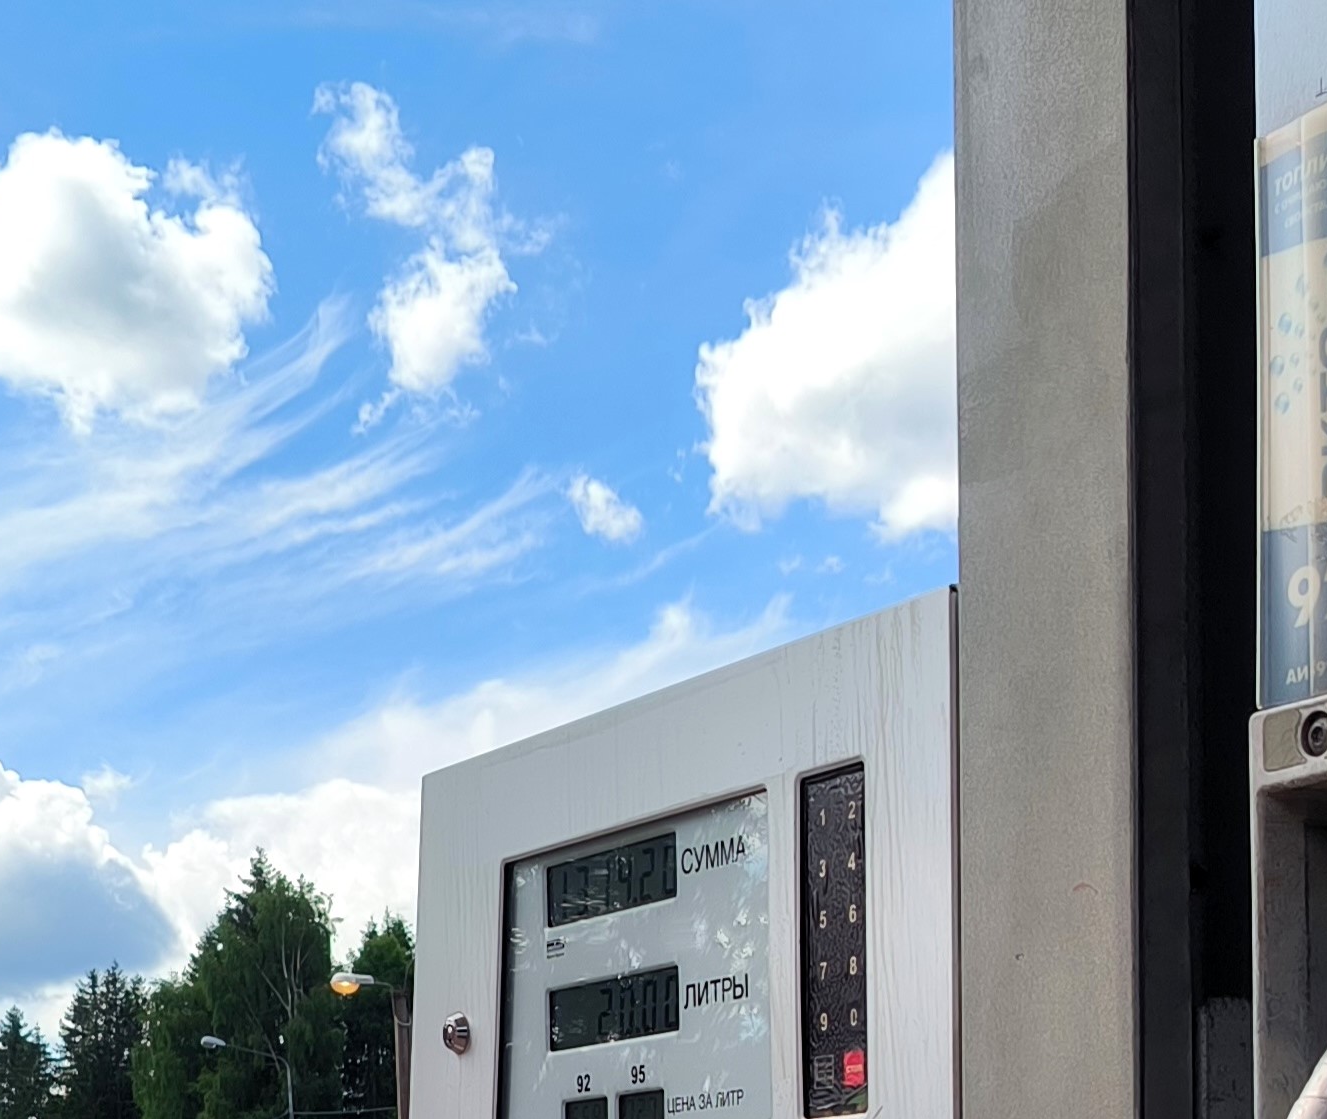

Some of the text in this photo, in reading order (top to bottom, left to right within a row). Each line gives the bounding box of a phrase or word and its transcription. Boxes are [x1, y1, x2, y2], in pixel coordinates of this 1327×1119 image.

[819, 801, 856, 826] 1 2
[681, 836, 746, 875] СУММА
[819, 852, 856, 878] 3 4
[819, 904, 857, 929] 5 6
[819, 956, 858, 981] 7 8
[683, 973, 749, 1009] ЛИТРЫ
[820, 1008, 858, 1032] 9 0
[576, 1073, 592, 1093] 92
[631, 1064, 646, 1084] 95
[667, 1096, 697, 1115] ЦЕНА
[698, 1093, 714, 1111] ЗА
[715, 1088, 745, 1109] ЛИТР
